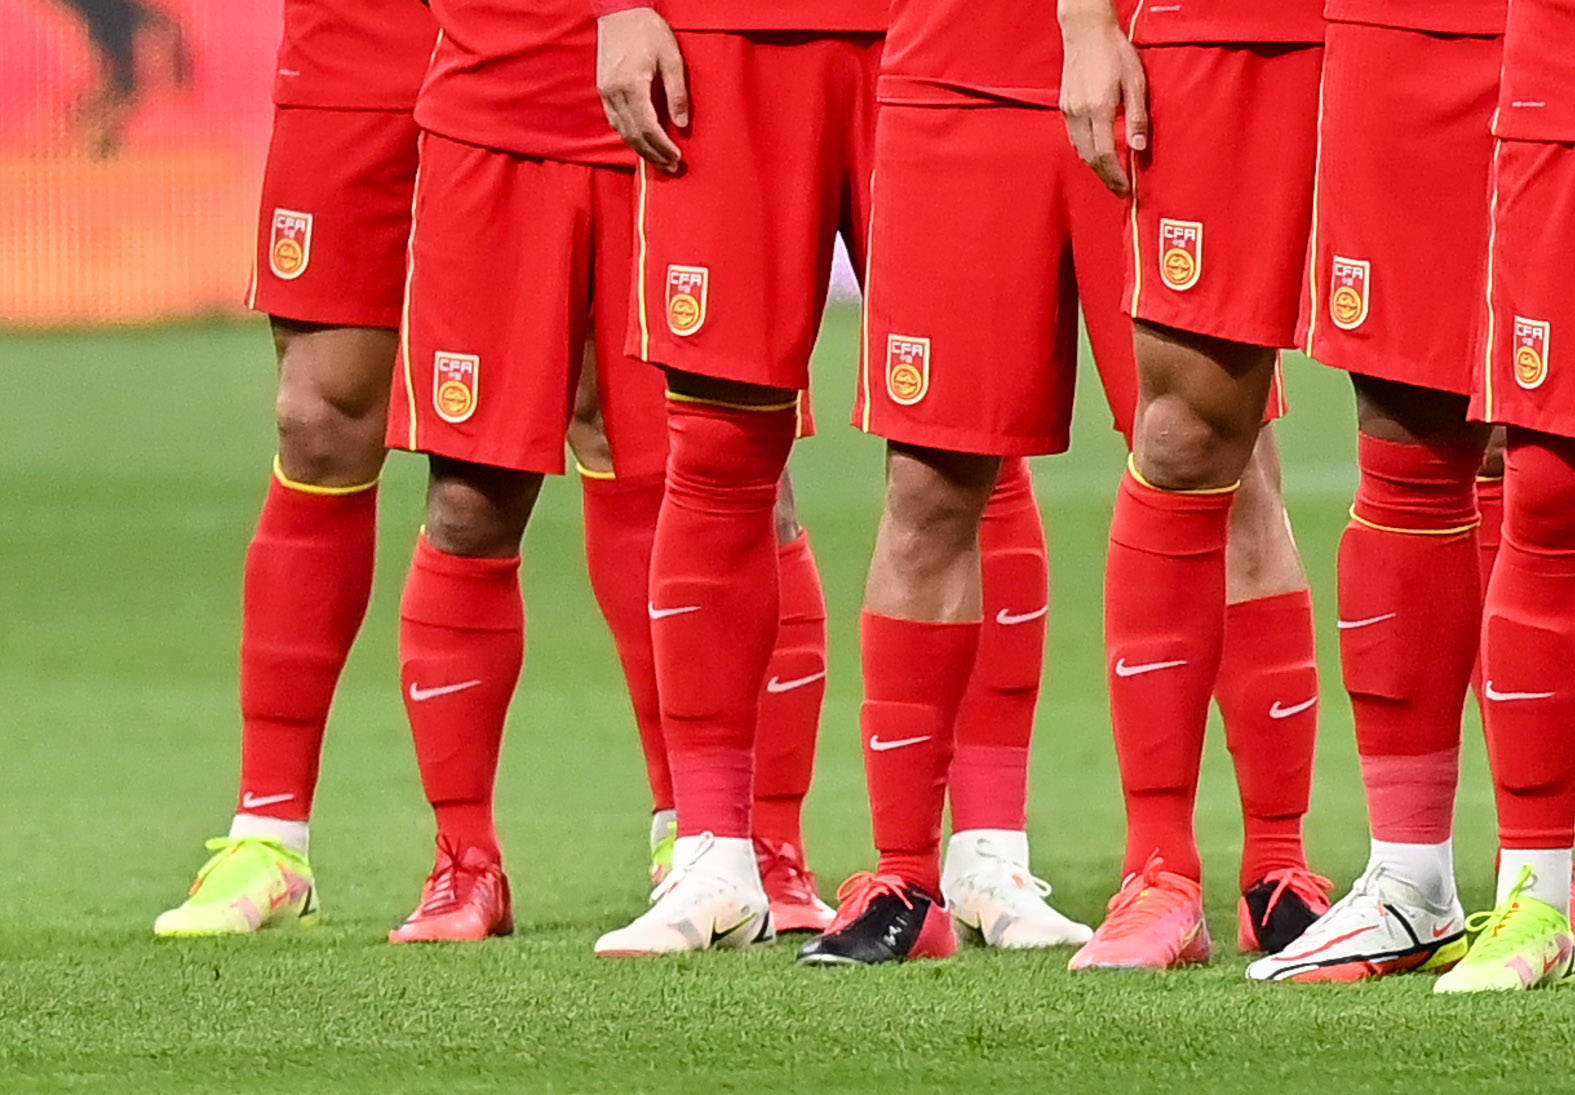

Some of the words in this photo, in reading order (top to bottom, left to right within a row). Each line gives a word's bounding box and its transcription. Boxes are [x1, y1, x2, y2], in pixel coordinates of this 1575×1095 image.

[1164, 225, 1196, 241] CFA
[670, 271, 702, 287] CFA
[1335, 263, 1363, 280] CFA
[1515, 323, 1543, 340] CFA
[891, 341, 923, 357] CFA
[439, 358, 473, 374] CFA
